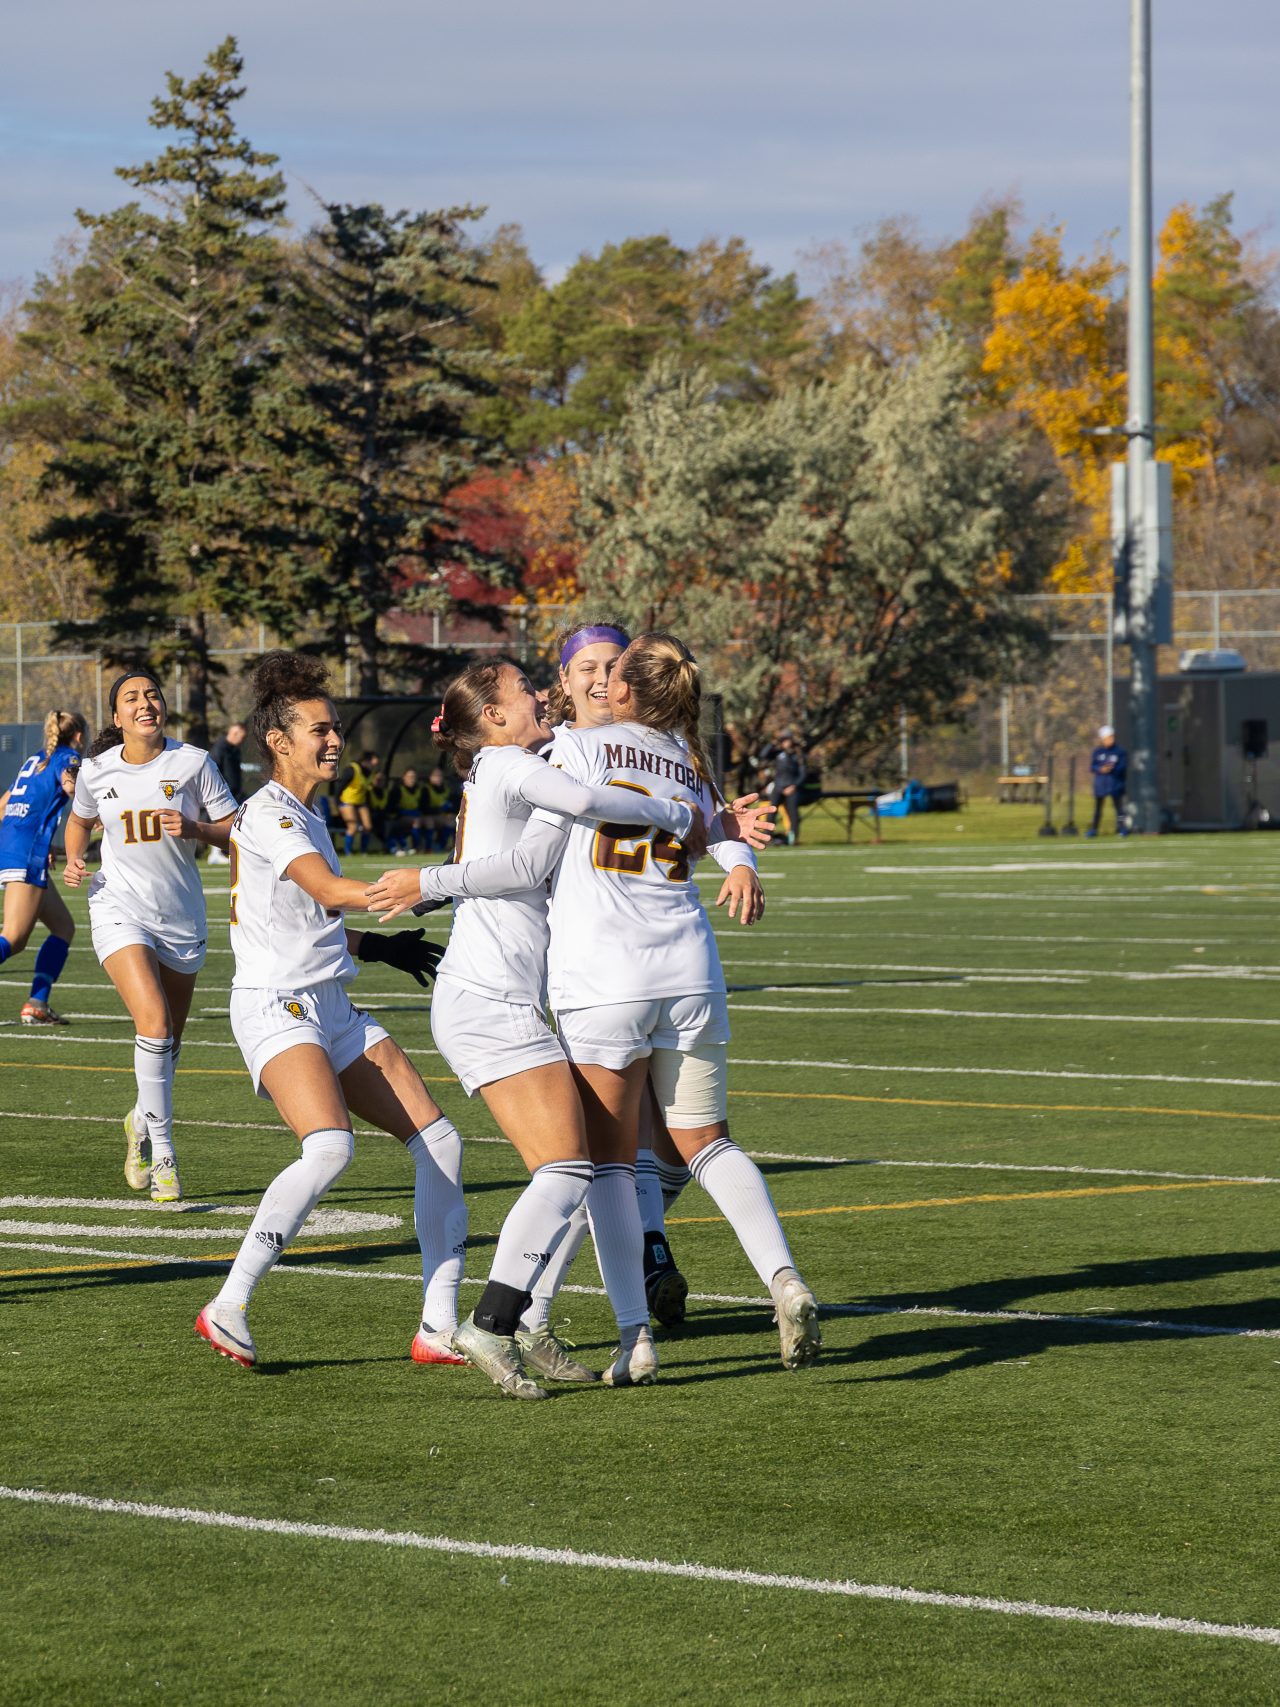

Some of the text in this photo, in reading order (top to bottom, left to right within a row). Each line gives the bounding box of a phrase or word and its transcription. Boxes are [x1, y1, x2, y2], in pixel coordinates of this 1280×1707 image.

[11, 755, 40, 796] 2
[603, 743, 705, 803] MANITOBA
[120, 809, 163, 844] 10
